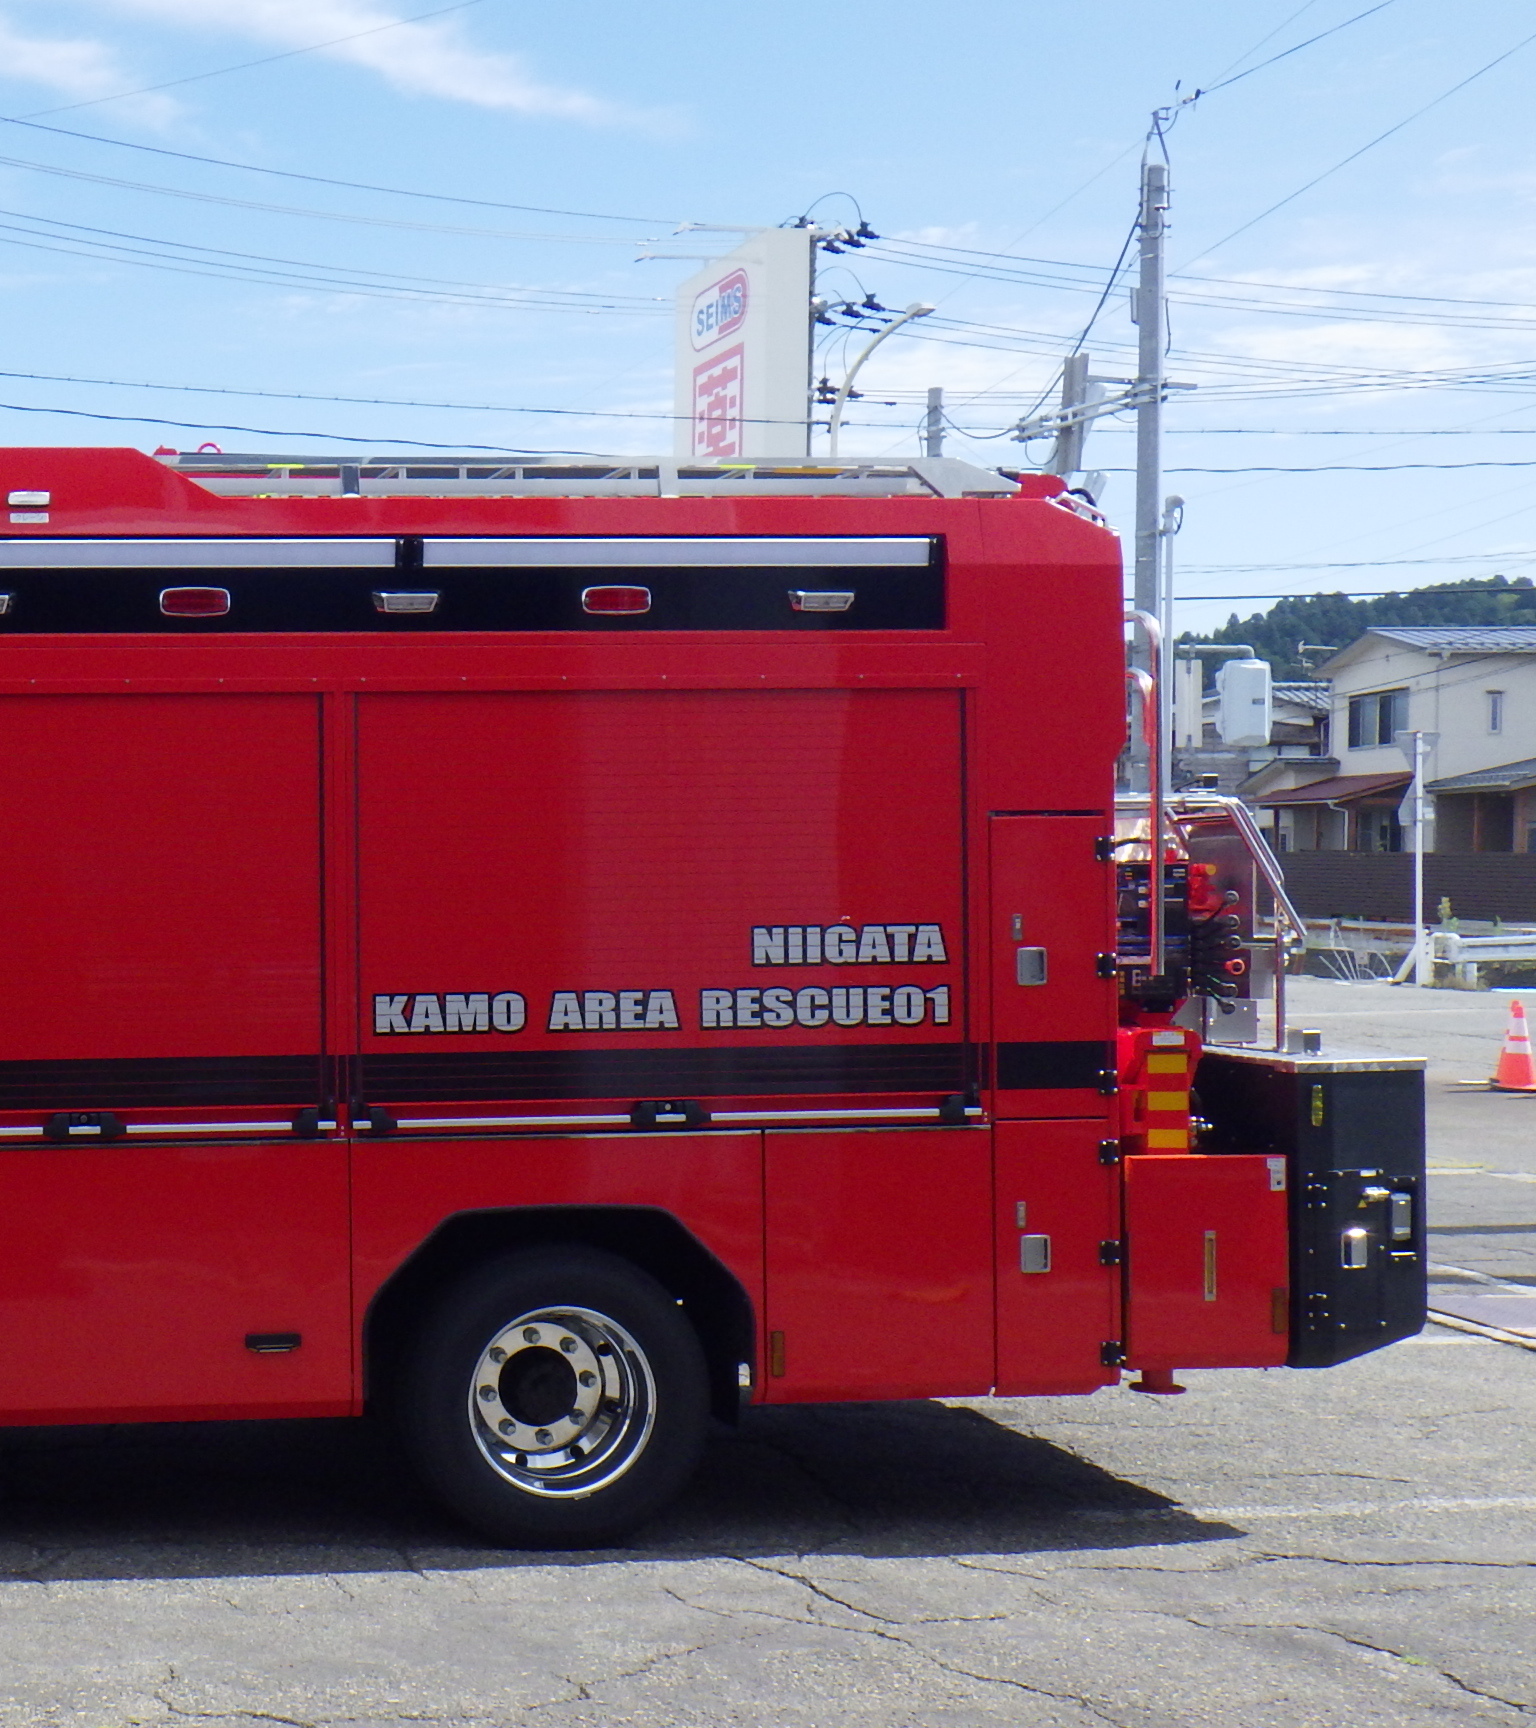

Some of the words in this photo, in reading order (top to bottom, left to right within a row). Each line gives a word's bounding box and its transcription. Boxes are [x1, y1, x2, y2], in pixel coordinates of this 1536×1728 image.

[697, 285, 742, 337] SEIMS
[751, 923, 950, 965] NIIGATA
[373, 992, 527, 1034] KAMO
[546, 989, 682, 1032] AREA
